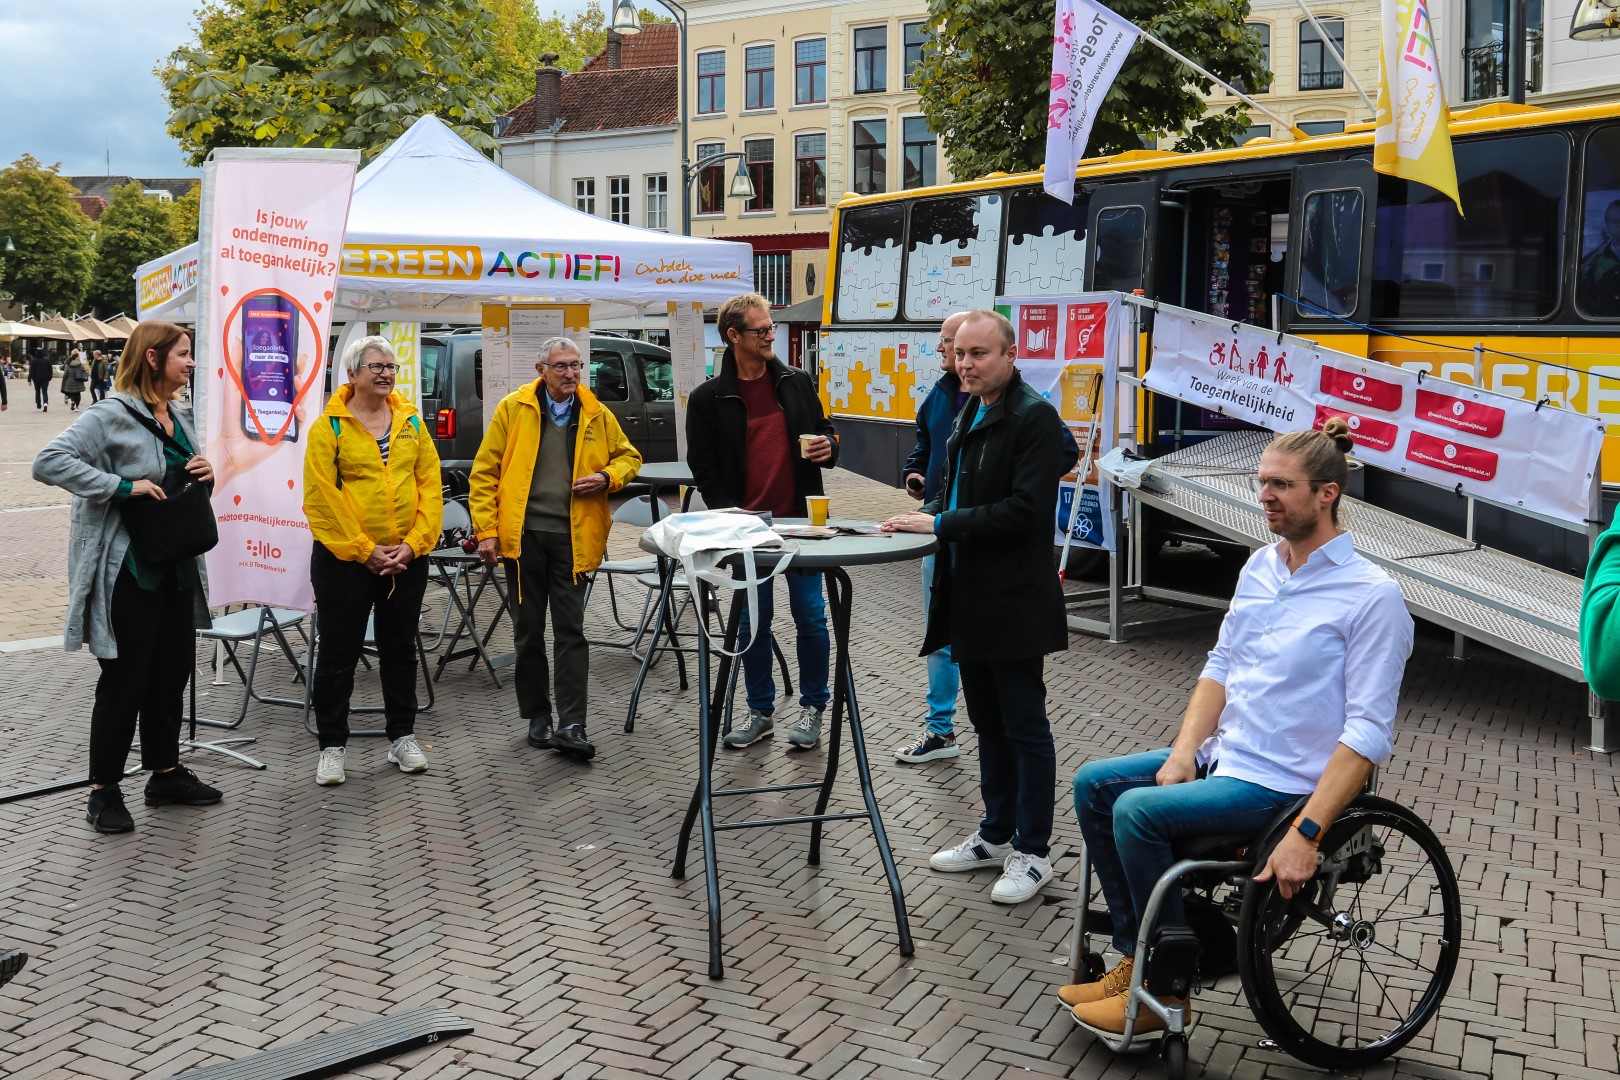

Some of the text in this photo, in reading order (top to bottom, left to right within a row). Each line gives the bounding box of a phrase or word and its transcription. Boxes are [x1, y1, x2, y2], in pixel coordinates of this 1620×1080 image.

[256, 209, 308, 231] Is jouw
[232, 226, 329, 258] onderneming
[220, 245, 336, 278] al toegankelijk?
[342, 249, 621, 283] EREEN ACTIEF!
[710, 264, 741, 280] mee!
[172, 259, 198, 294] ACTIEF
[1022, 308, 1028, 321] 4
[1070, 308, 1076, 321] 5
[1217, 369, 1273, 396] Week van de
[1189, 375, 1295, 422] Toegankelijkheid
[1063, 491, 1072, 504] 17
[427, 1032, 439, 1043] 26
